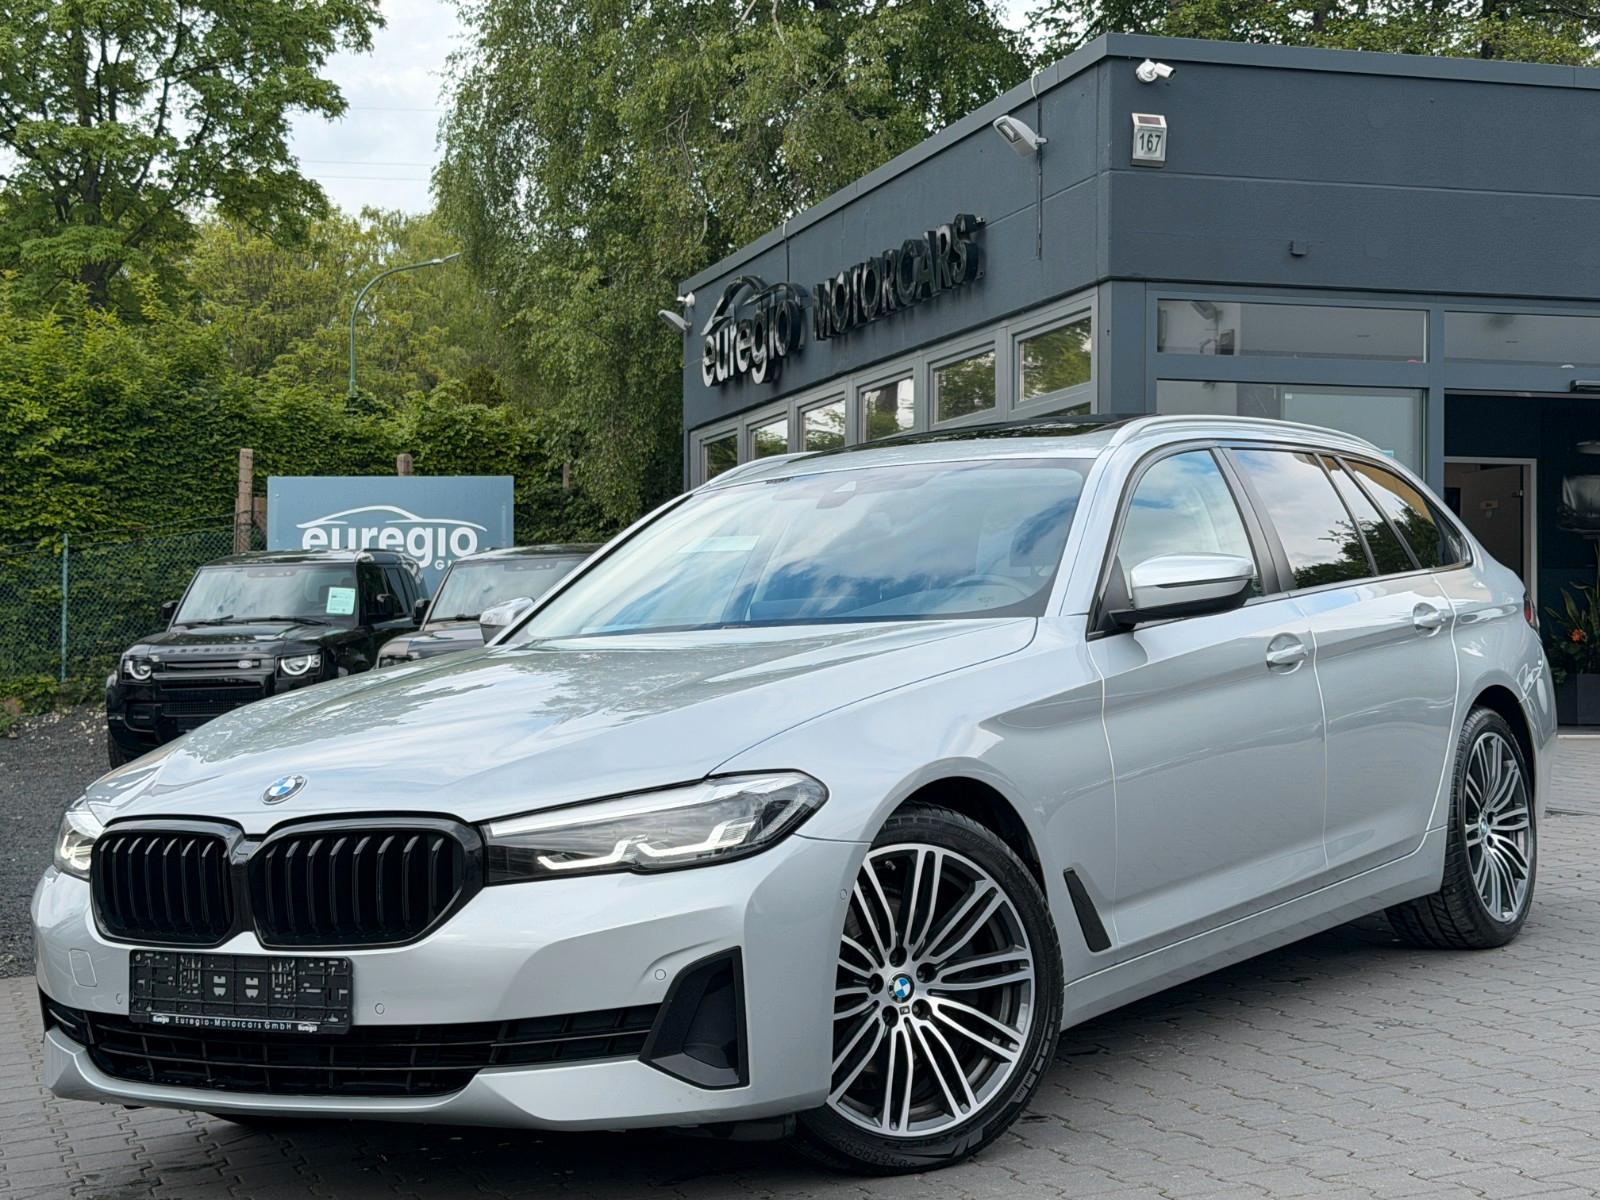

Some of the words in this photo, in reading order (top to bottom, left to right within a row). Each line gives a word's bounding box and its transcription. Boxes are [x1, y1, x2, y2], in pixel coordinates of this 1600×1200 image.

[1138, 131, 1162, 153] 167
[702, 300, 800, 387] euregio
[812, 213, 977, 341] MOTORCARS
[302, 526, 478, 569] euregio
[264, 1020, 292, 1030] GmbH
